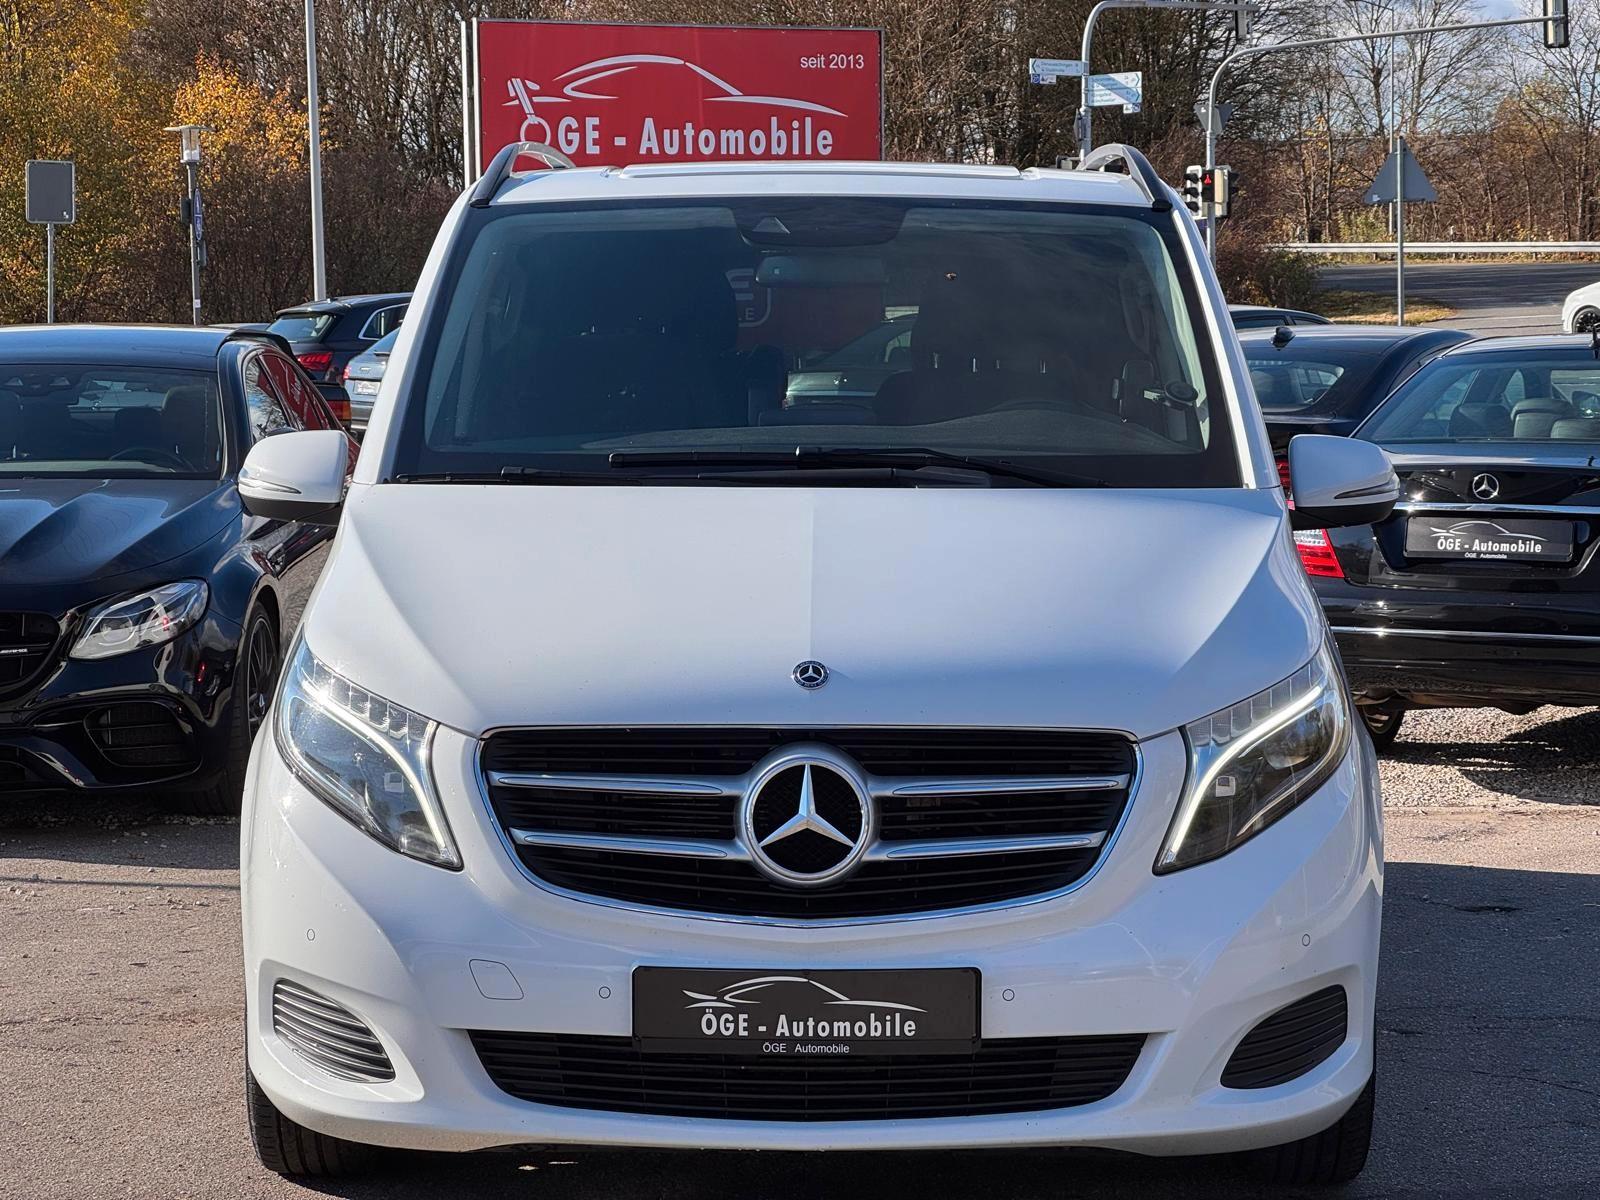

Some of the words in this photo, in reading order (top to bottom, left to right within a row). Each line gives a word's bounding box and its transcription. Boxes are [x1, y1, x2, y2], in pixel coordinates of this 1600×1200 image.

[800, 53, 826, 69] seit
[829, 54, 864, 70] 2013
[639, 116, 833, 155] Automobile
[1437, 536, 1461, 550] ÖGE
[1472, 538, 1542, 553] Automobile
[701, 1008, 749, 1036] ÖGE
[775, 1013, 916, 1037] Automobile
[763, 1042, 787, 1053] ÖGE
[795, 1043, 850, 1054] Automobile
